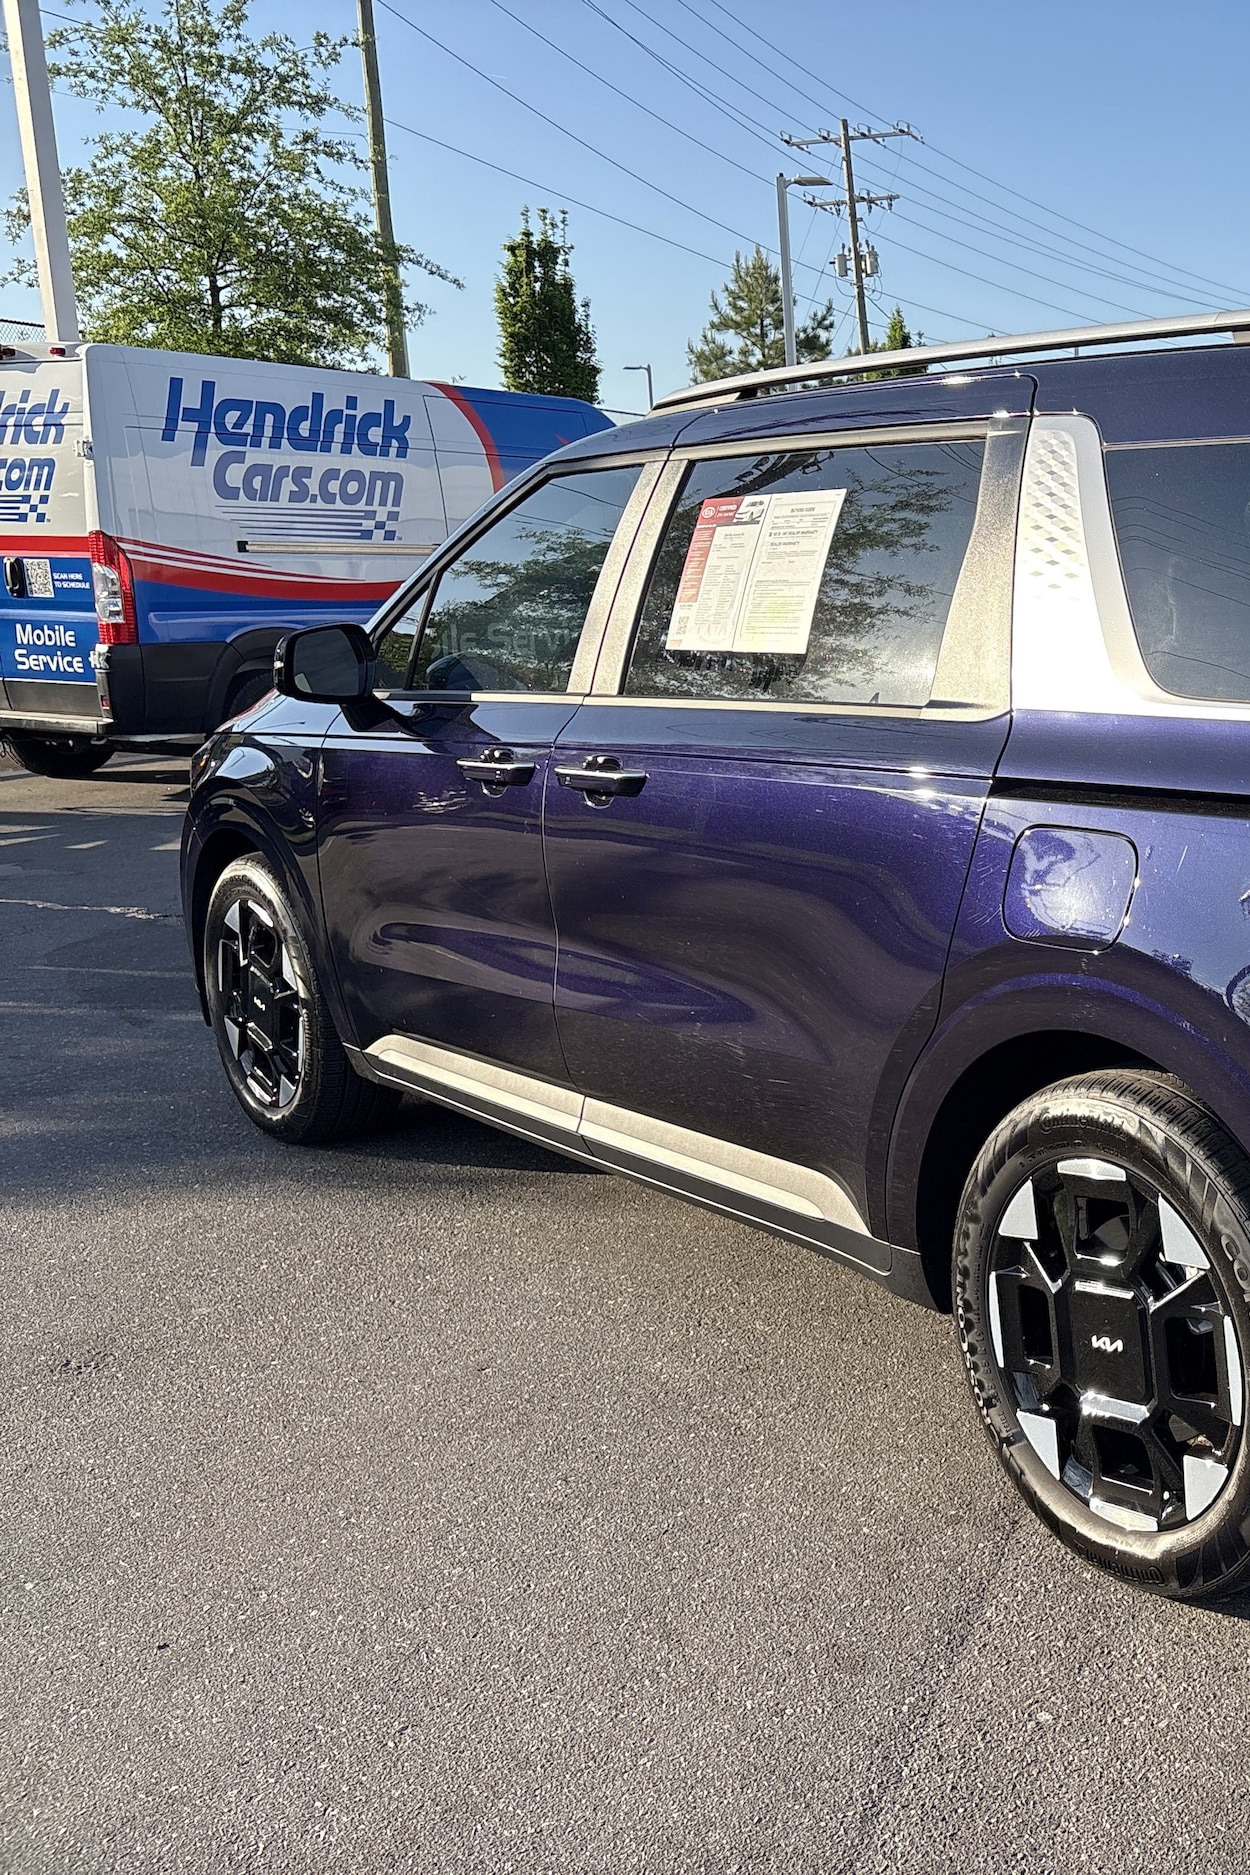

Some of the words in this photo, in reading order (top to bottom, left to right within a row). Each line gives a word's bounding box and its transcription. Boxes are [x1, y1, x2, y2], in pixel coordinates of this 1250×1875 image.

[0, 388, 70, 445] rick
[161, 377, 411, 466] Hendrick
[213, 450, 404, 507] Cars.com
[53, 572, 68, 580] SCAN
[69, 573, 83, 581] HERE
[62, 581, 91, 590] SCHEDULE
[15, 623, 77, 647] Mobile
[14, 648, 85, 673] Service
